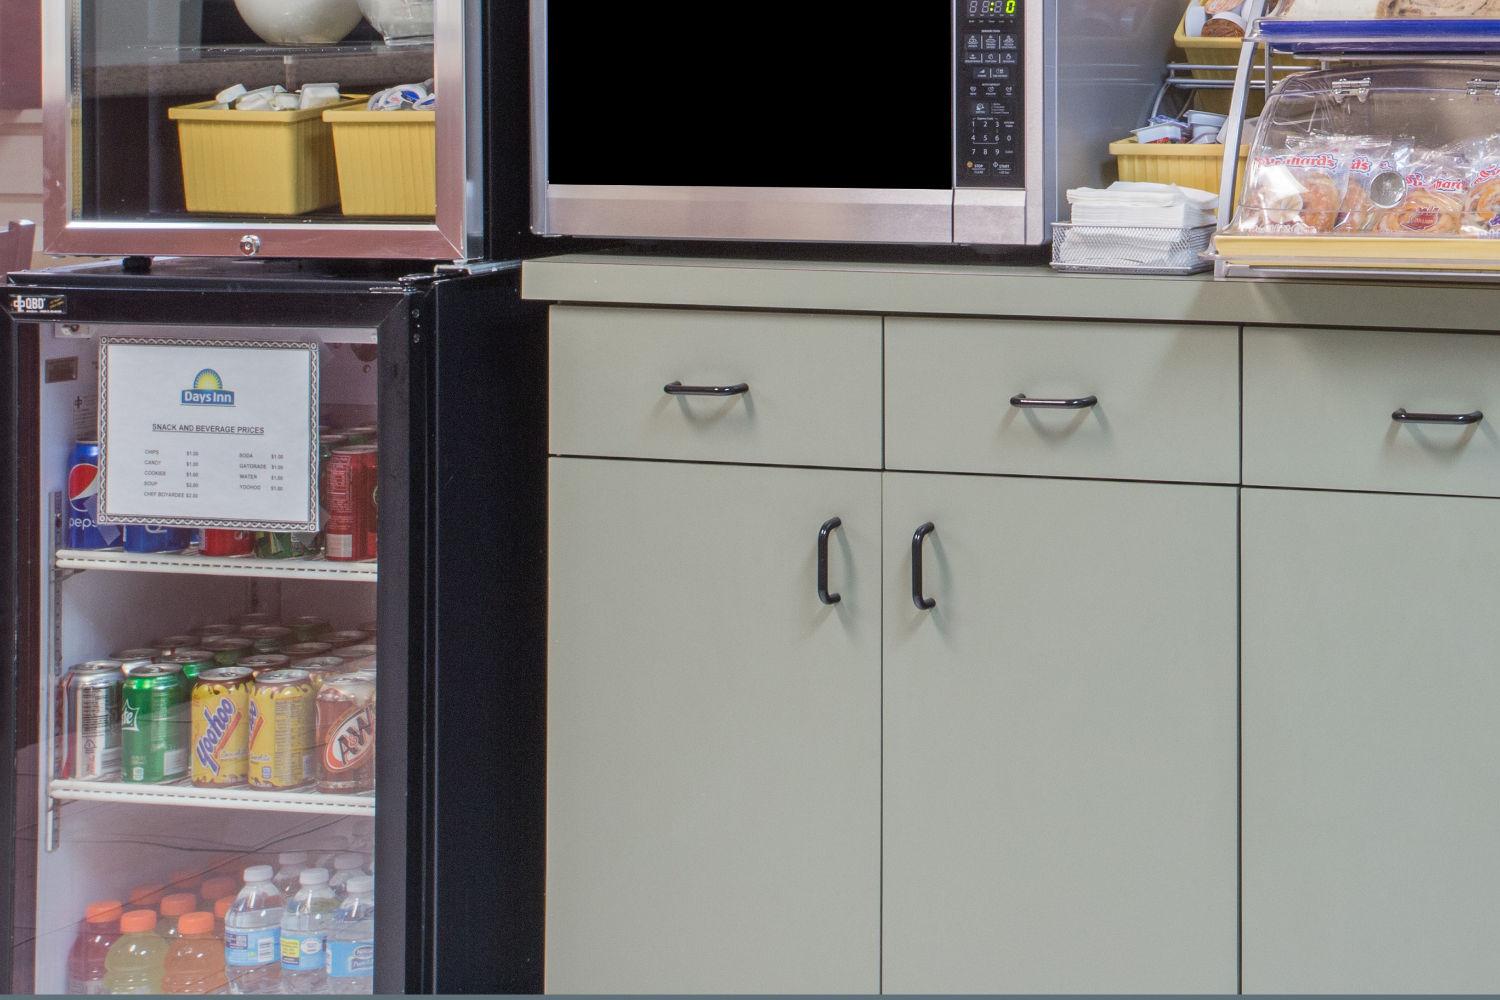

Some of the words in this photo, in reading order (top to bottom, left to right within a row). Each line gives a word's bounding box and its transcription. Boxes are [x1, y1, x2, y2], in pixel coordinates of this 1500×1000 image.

[184, 391, 211, 404] Days
[213, 392, 232, 403] Inn
[179, 424, 194, 432] AND
[196, 425, 236, 433] BEVERAGE
[237, 426, 264, 434] PRICES
[69, 517, 98, 531] peps
